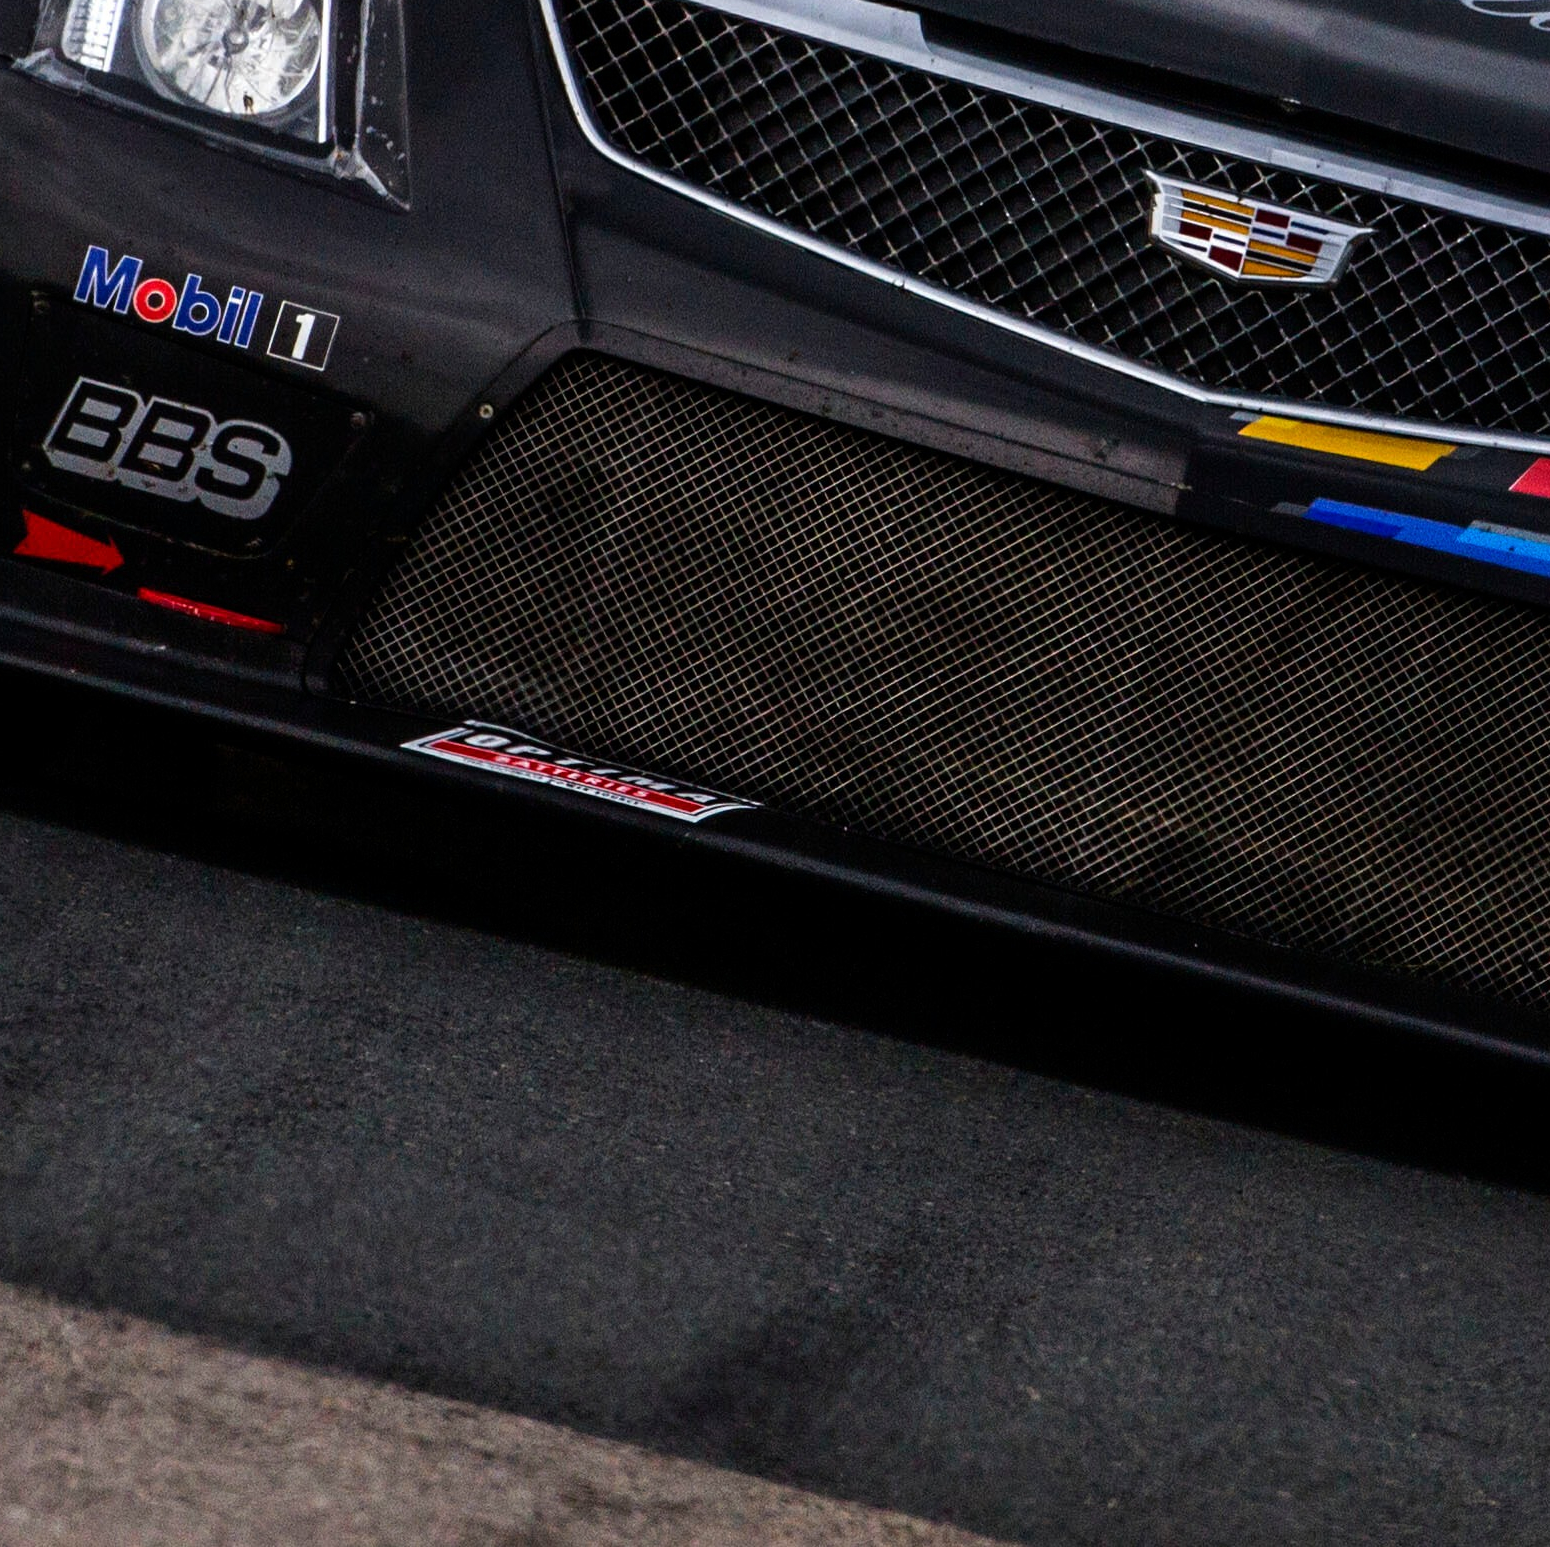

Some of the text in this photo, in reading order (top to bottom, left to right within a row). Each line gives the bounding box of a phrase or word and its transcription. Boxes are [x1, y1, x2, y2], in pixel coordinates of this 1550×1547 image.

[73, 245, 264, 348] Mobil
[42, 376, 293, 520] BBS
[463, 733, 718, 804] OPTIMA
[494, 755, 651, 798] BATTERIES
